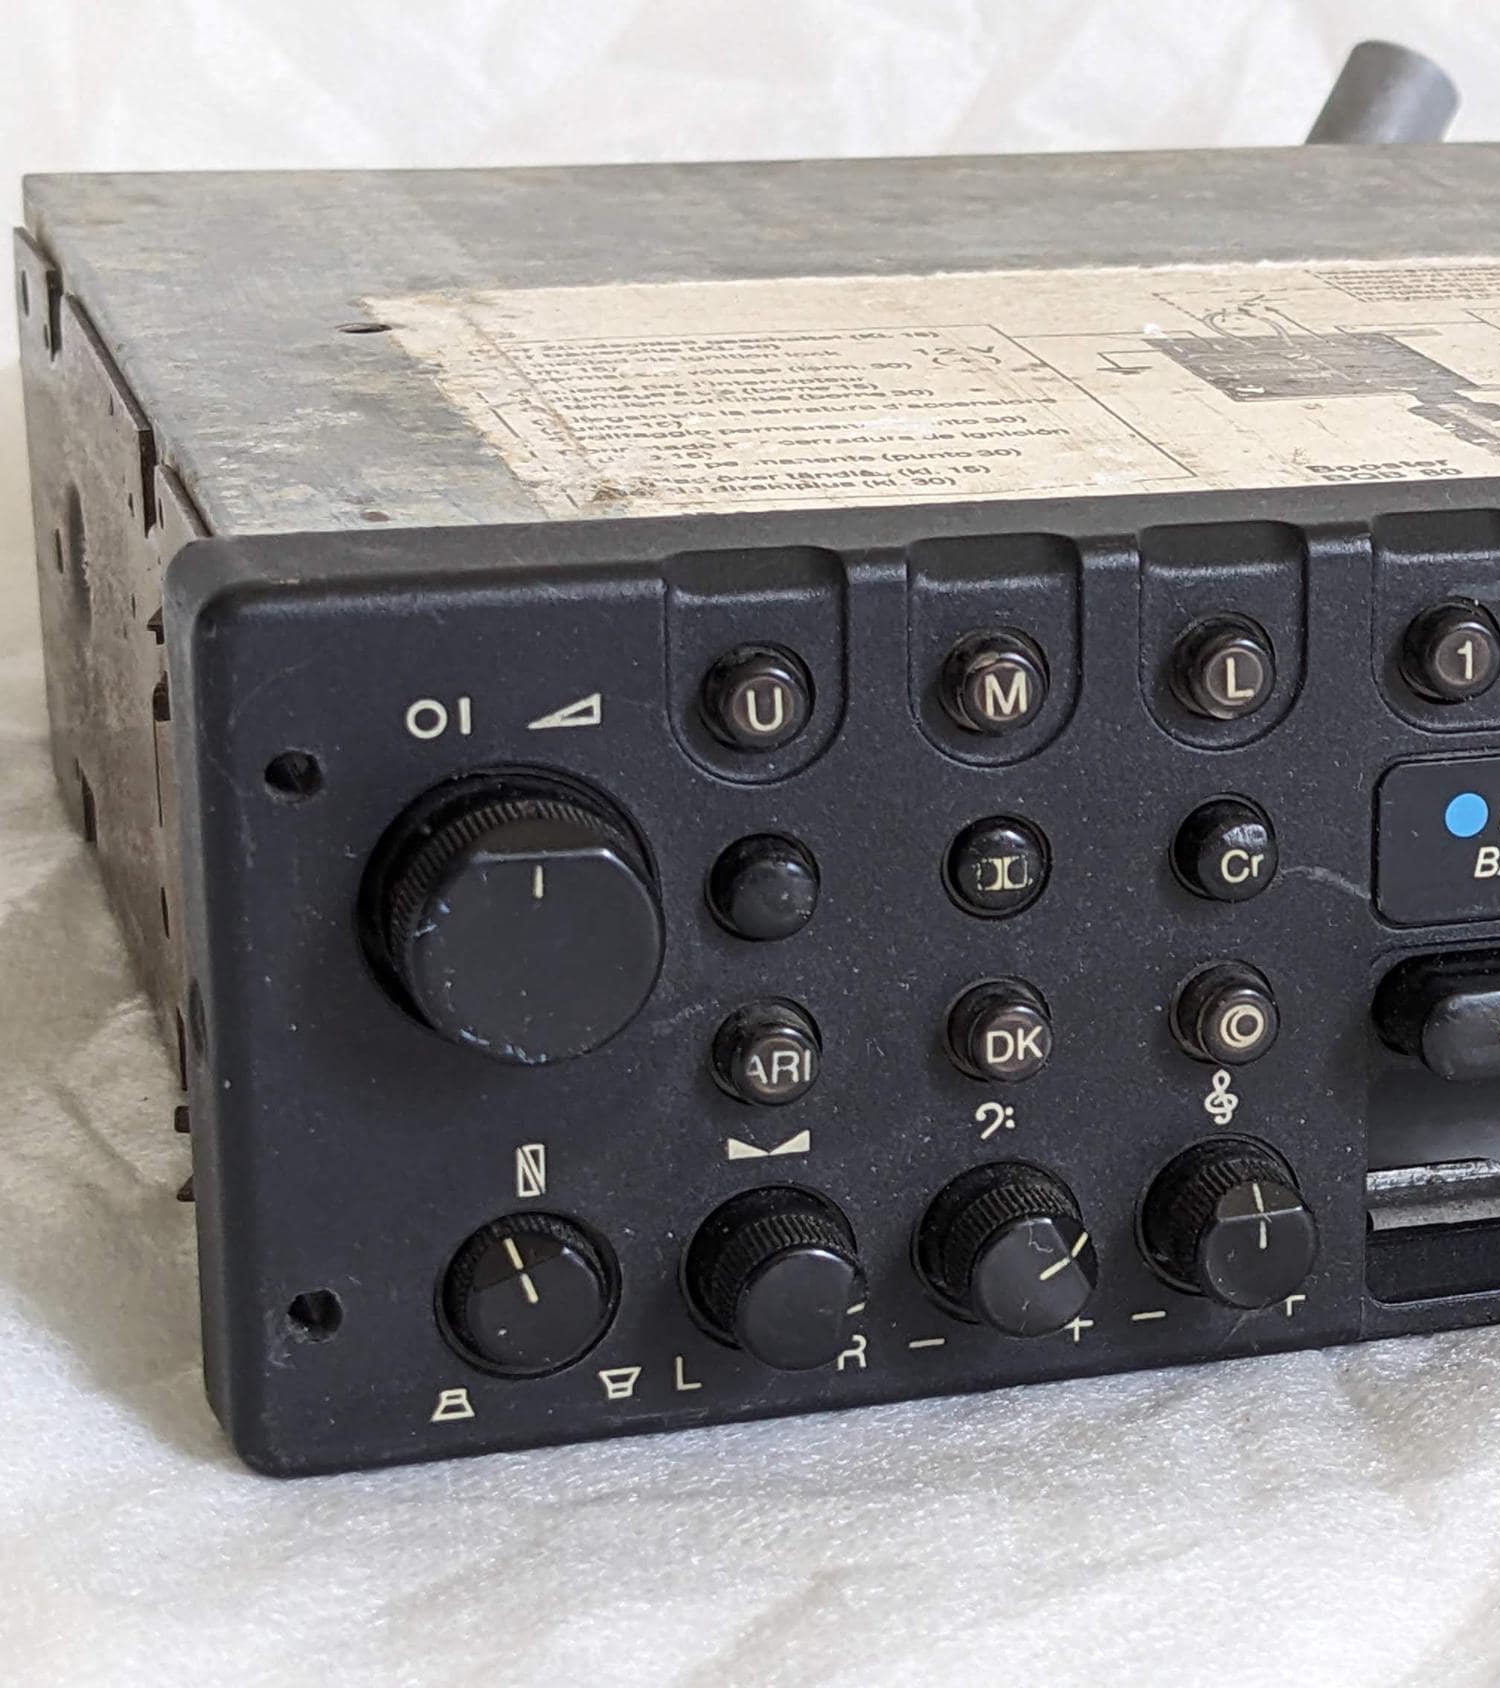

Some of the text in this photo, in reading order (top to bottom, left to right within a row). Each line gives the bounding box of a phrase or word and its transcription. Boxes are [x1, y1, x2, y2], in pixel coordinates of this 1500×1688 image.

[1306, 459, 1448, 474] Booster
[1225, 654, 1255, 701] L
[1457, 641, 1474, 680] 1
[746, 688, 785, 732] U
[983, 668, 1030, 718] M
[1221, 847, 1264, 884] Cr
[986, 1026, 1043, 1064] DK
[748, 1048, 812, 1086] ARI
[676, 1356, 702, 1391] L
